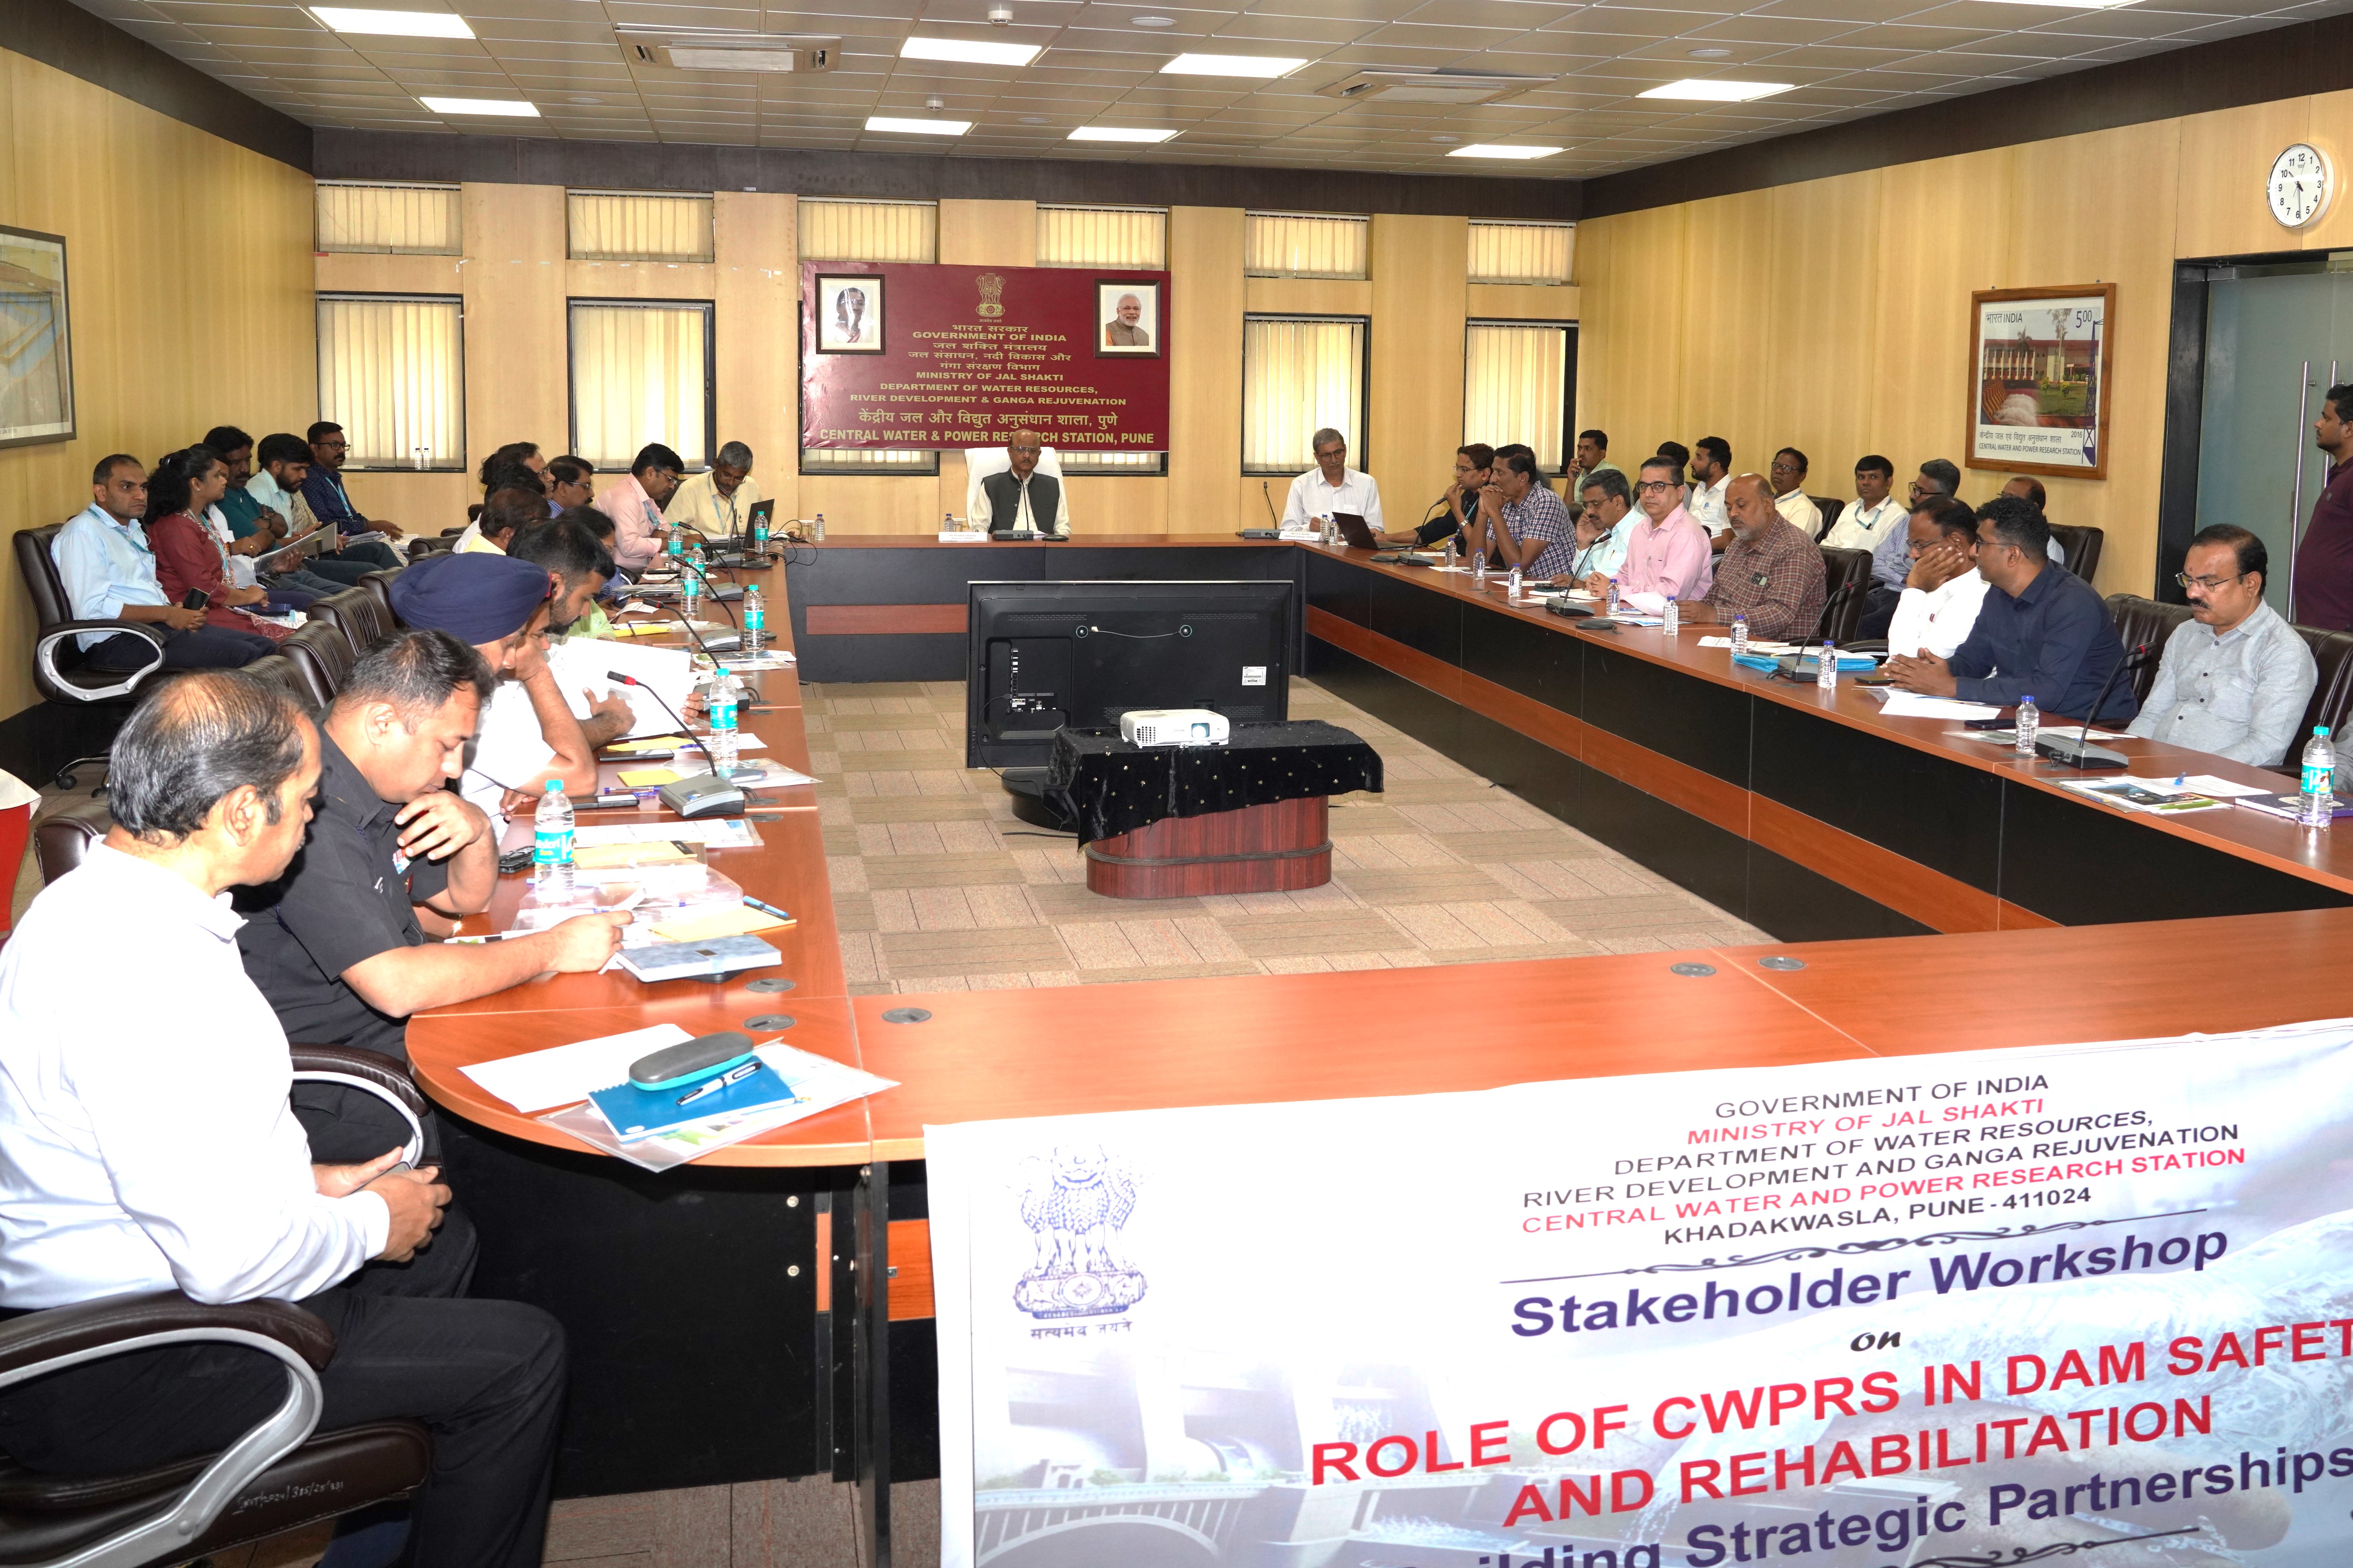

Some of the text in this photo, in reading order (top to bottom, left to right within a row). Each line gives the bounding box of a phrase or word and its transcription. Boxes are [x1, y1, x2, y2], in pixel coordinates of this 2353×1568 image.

[2298, 153, 2304, 162] 12
[1987, 314, 2002, 324] भारत
[2003, 313, 2022, 323] INDIA
[912, 331, 1005, 339] GOVERNMENT
[934, 350, 978, 360] संसाधन,
[984, 351, 1003, 360] नदी
[1008, 352, 1045, 360] विकास
[1003, 342, 1047, 350] मंत्रालय
[966, 362, 1001, 370] संरक्षण
[1007, 362, 1040, 370] विभाग
[859, 408, 1118, 430] केंद्रीय जल और विद्युत अनुसंधान शाला, पुणे
[820, 429, 880, 440] CENTRAL
[883, 430, 927, 440] WATER
[931, 431, 940, 441] &
[945, 431, 989, 441] POWER
[1062, 432, 1117, 444] STATION,
[1121, 433, 1153, 443] PUNE
[2014, 432, 2026, 443] विद्युत
[2028, 433, 2048, 444] अनुसंधान
[1716, 1075, 2048, 1118] GOVERNMENT OF INDIA
[1688, 1099, 2043, 1144] MINISTRY OF JAL SHAKTI
[1615, 1111, 2155, 1175] DEPARTMENT OF WATER RESOURCES,
[1524, 1124, 2238, 1207] RIVER DEVELOPMENT AND GANGA REJUVENATION
[1523, 1148, 2244, 1232] CENTRAL WATER AND POWER RESEARCH STATION
[1665, 1207, 1899, 1245] KHADAKWASLA,
[1511, 1231, 2227, 1338] Stakeholder Workshop
[1030, 1323, 1088, 1339] सत्यमेव
[1852, 1332, 1900, 1351] on
[1312, 1420, 1511, 1486] ROLE
[1536, 1404, 1628, 1455] OF
[1653, 1371, 1903, 1444] CWPRS
[1925, 1361, 1981, 1406] IN
[2007, 1342, 2145, 1395] DAM
[1503, 1394, 2212, 1527] AND REHABILITATION
[1686, 1495, 1966, 1568] Strategic
[1988, 1446, 2353, 1526] Partnerships
